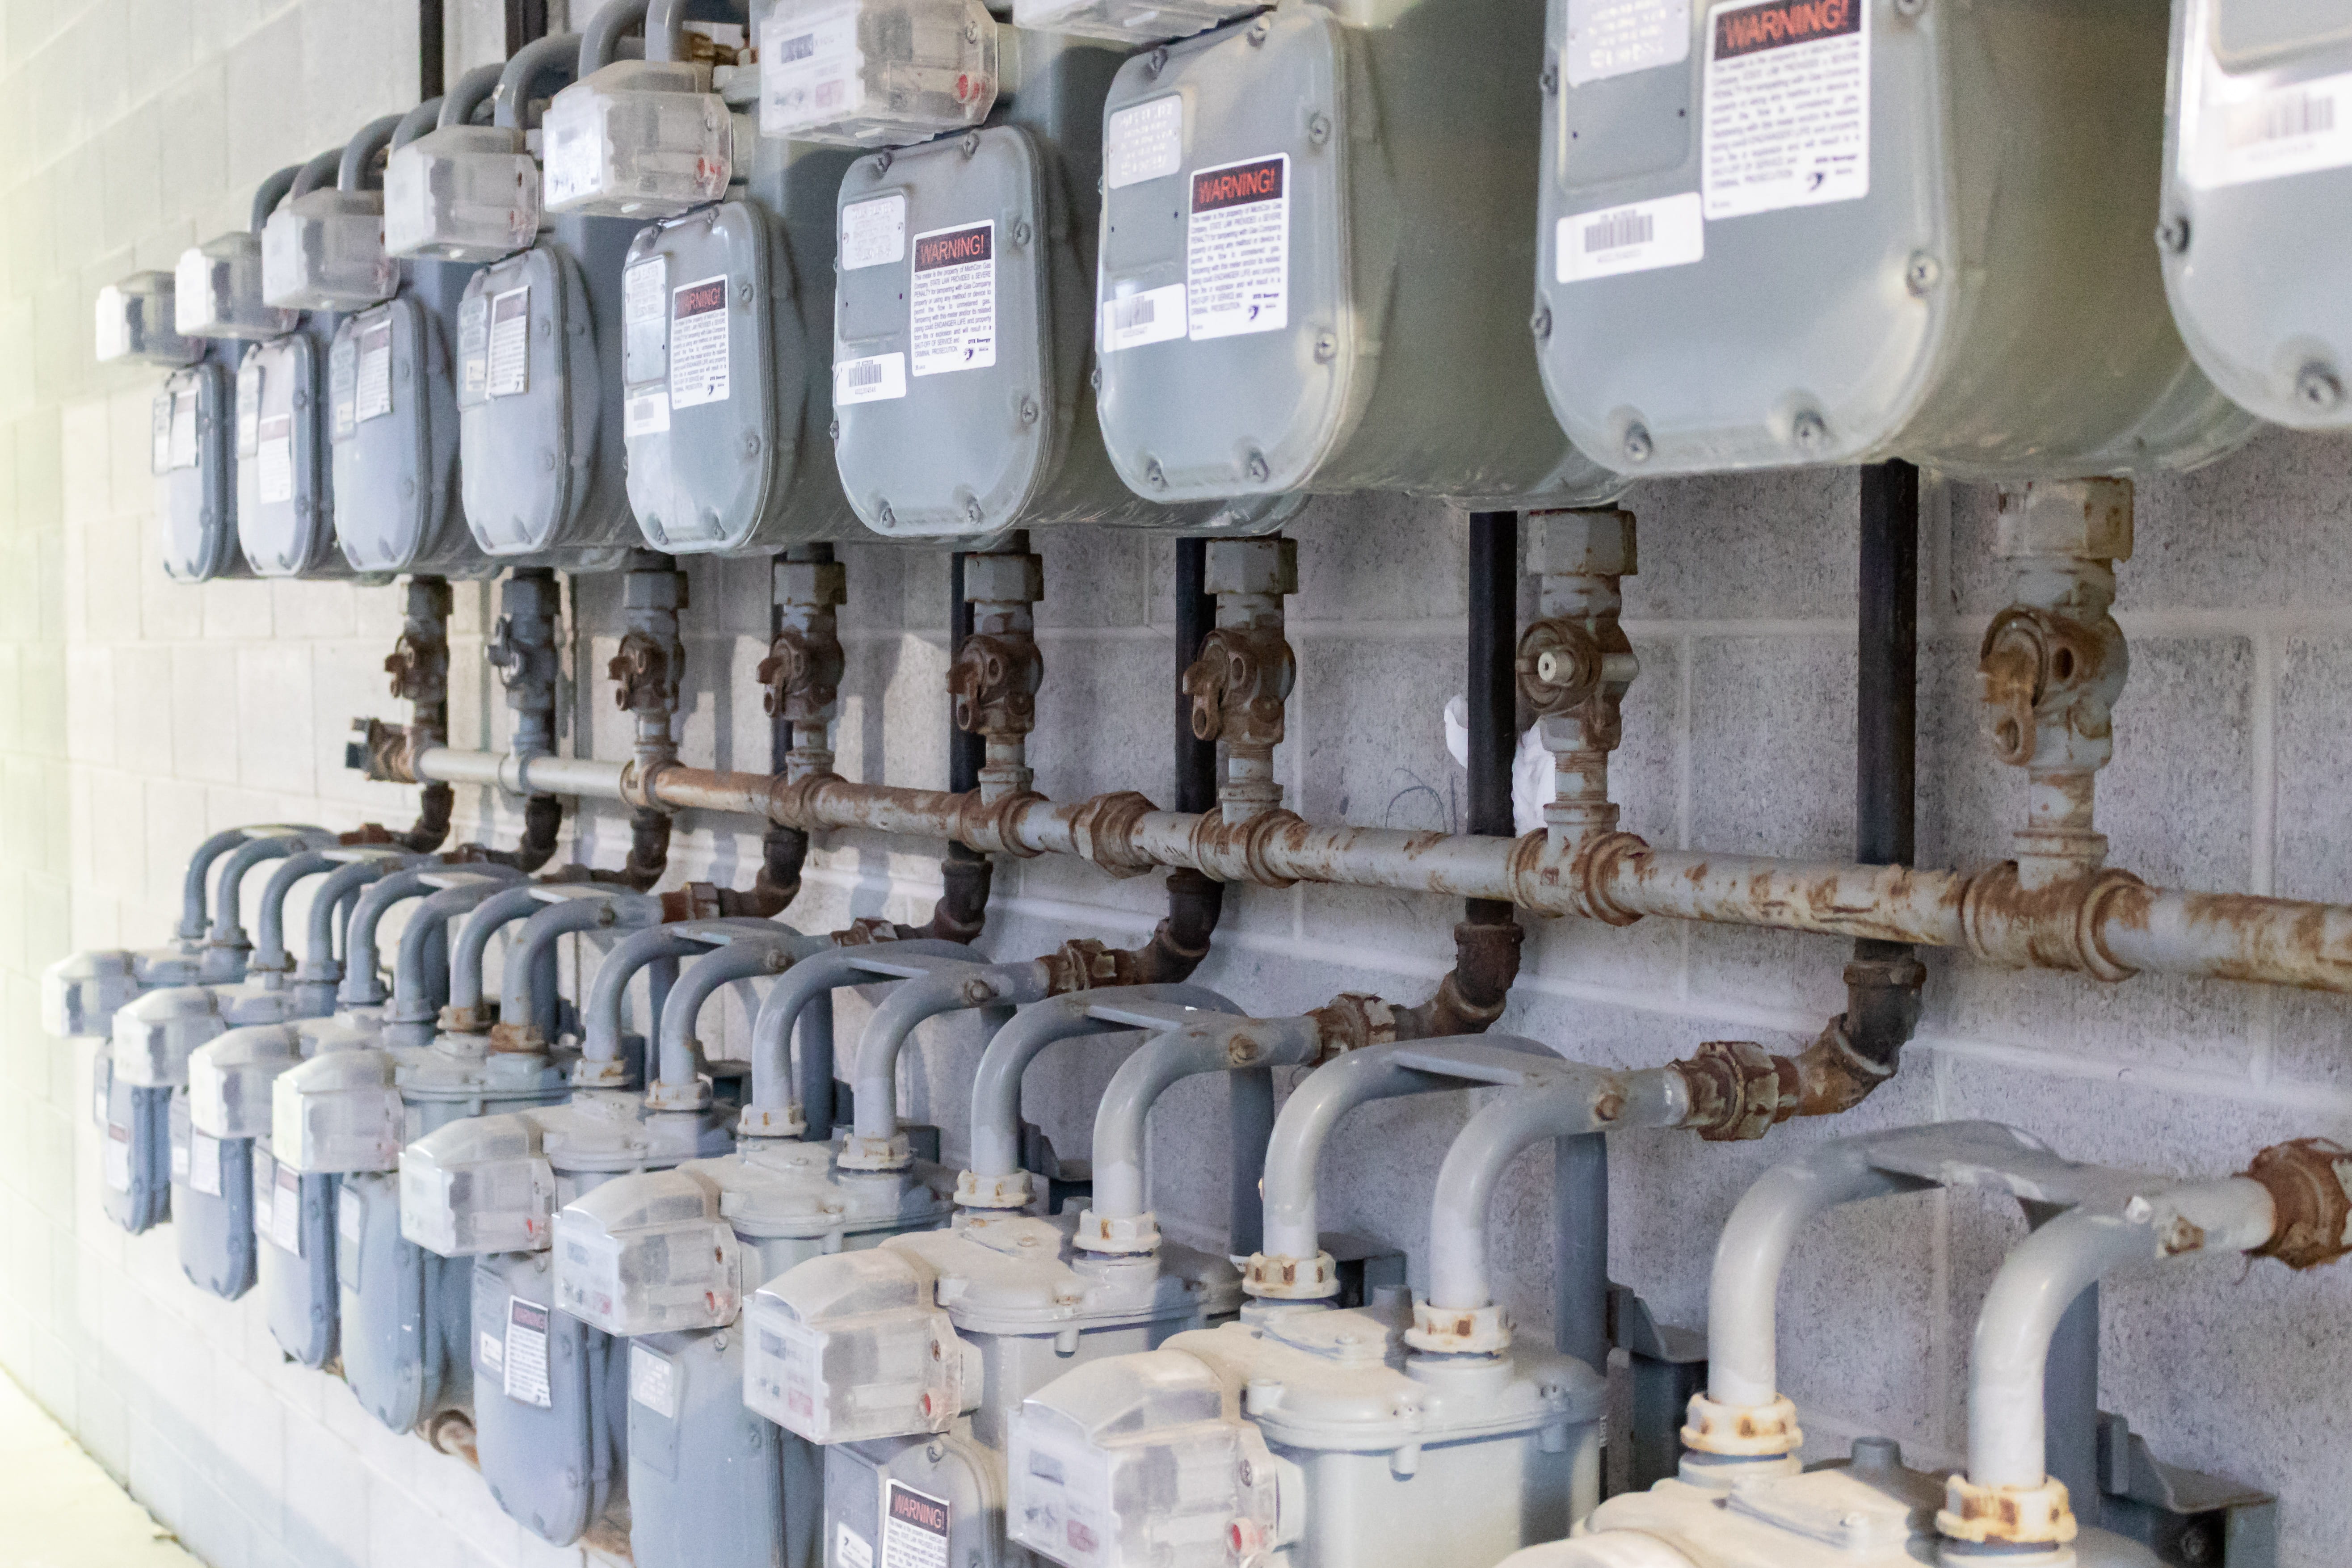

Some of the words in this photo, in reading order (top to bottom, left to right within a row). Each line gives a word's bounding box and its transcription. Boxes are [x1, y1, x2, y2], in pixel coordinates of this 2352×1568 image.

[1199, 167, 1275, 204] WARNING!
[921, 234, 985, 264] WARNING!
[893, 1492, 945, 1530] WARNING!
